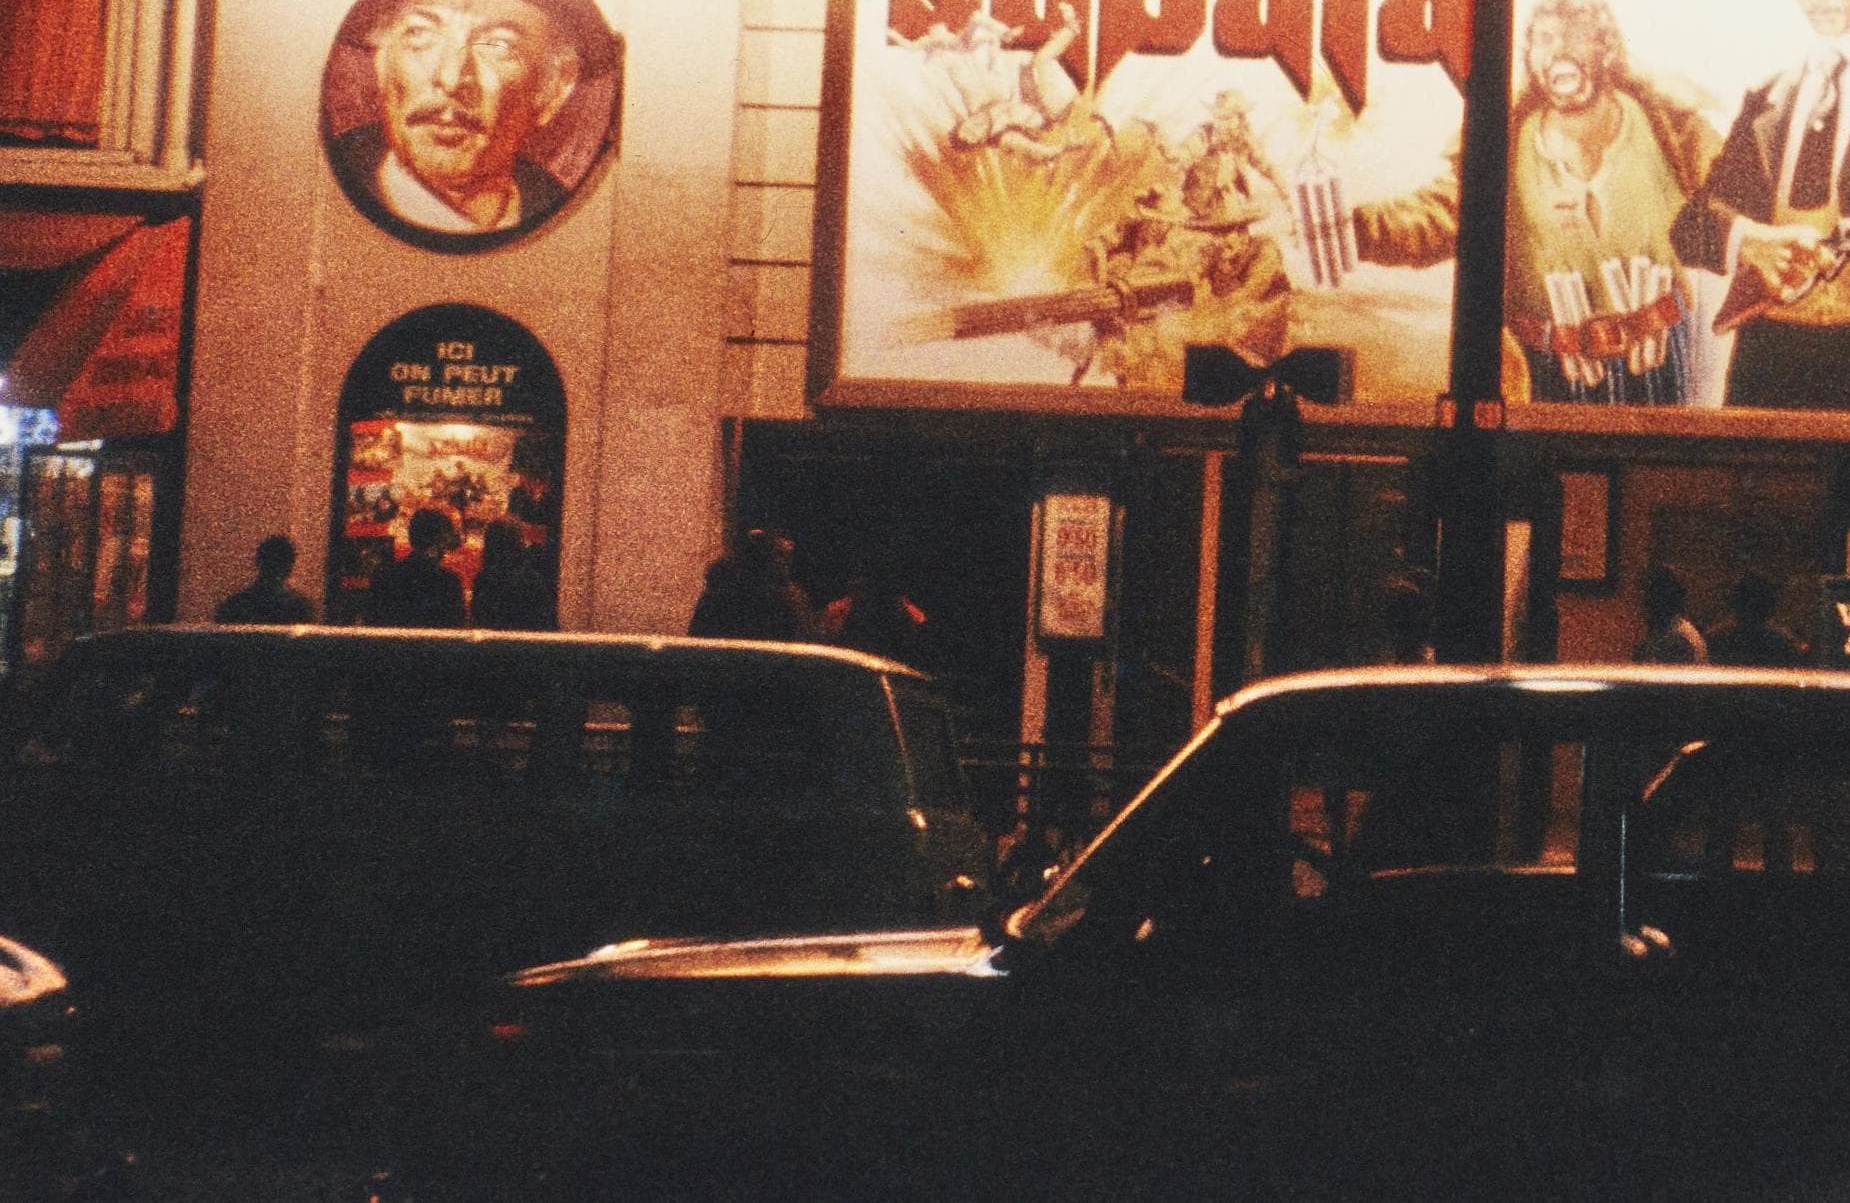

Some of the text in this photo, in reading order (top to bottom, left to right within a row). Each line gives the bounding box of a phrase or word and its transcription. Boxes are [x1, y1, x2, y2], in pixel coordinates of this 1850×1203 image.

[435, 341, 476, 361] ICI
[389, 362, 521, 384] ON PEUT
[402, 385, 503, 406] FUMER
